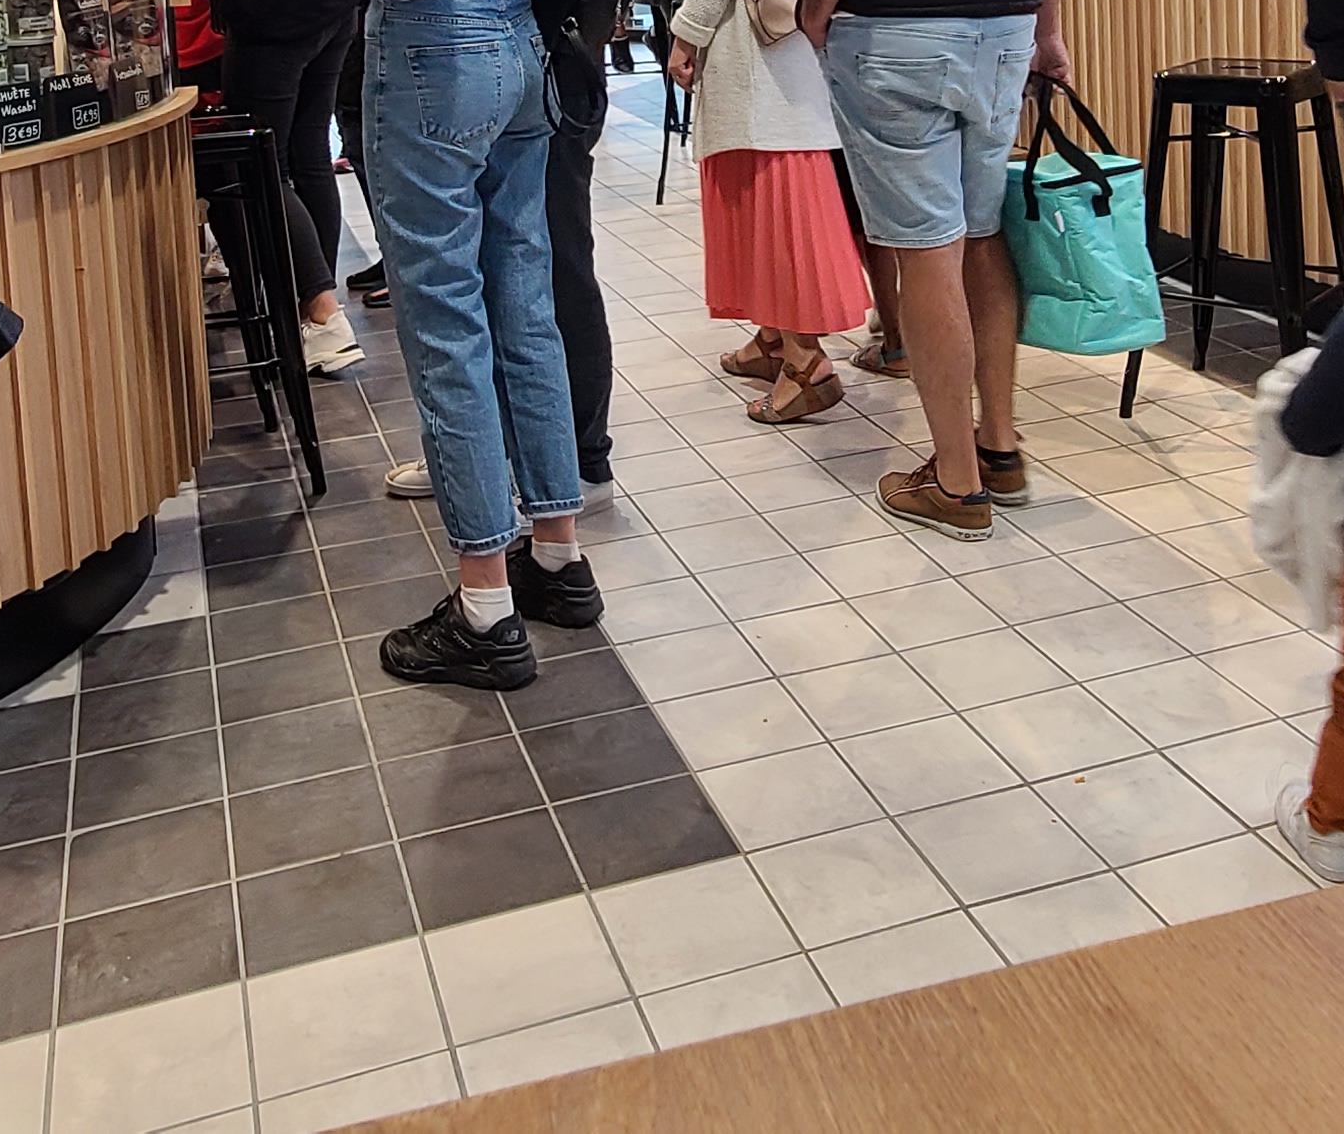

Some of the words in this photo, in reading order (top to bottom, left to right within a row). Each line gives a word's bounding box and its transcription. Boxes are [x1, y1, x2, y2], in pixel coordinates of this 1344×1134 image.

[1, 100, 37, 117] Wasabi
[75, 108, 98, 126] 3€95
[7, 124, 39, 142] 3€95
